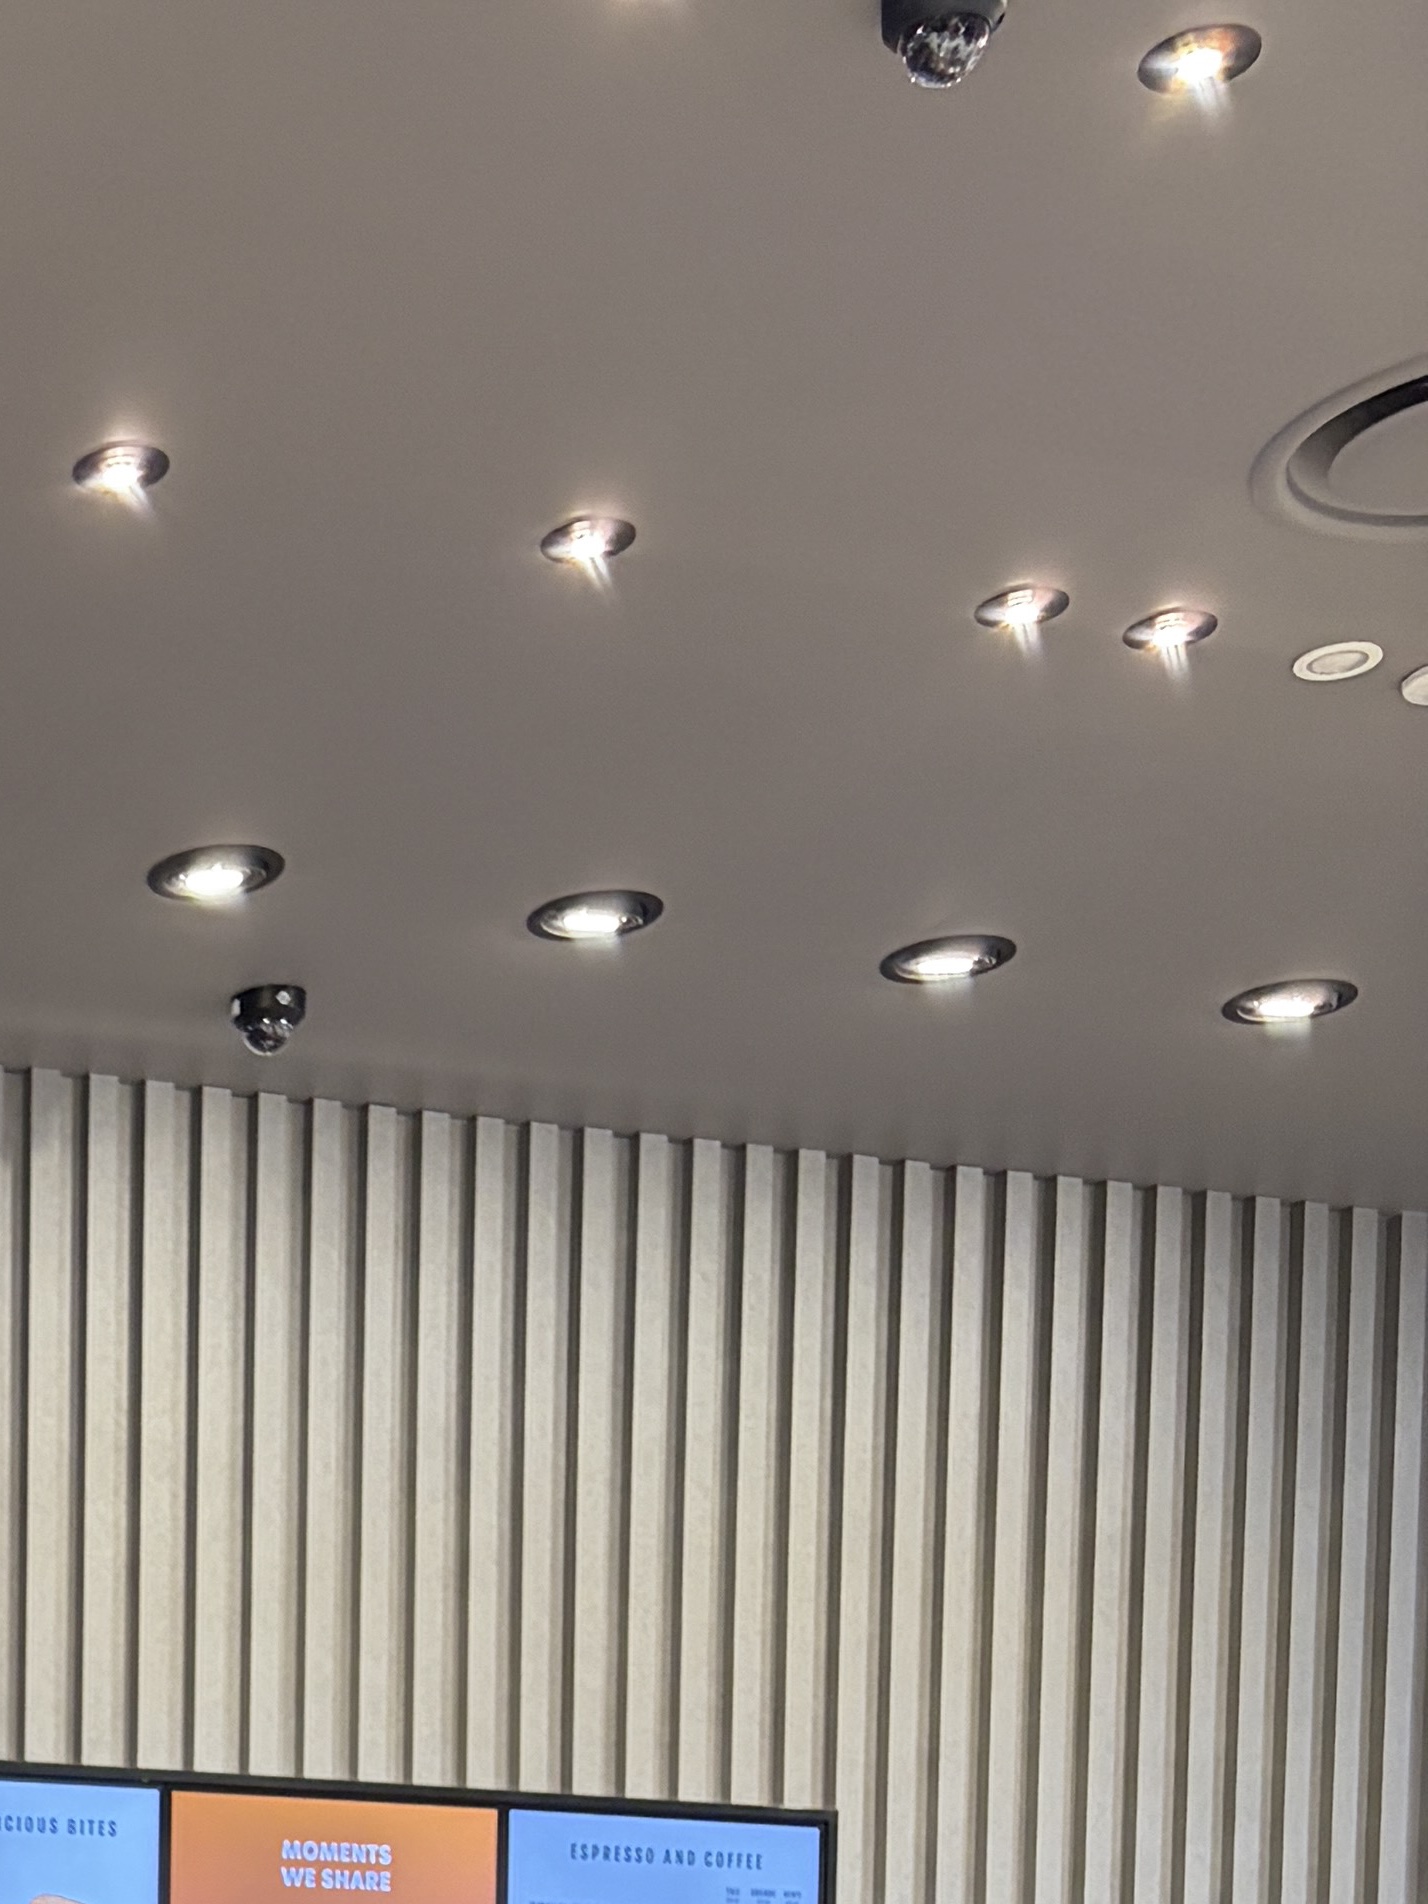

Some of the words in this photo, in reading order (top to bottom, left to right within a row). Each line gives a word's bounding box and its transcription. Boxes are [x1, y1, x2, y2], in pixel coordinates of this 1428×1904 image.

[67, 1818, 118, 1837] BITES
[281, 1839, 392, 1865] MOMENTS
[570, 1842, 654, 1864] ESPRESSO
[662, 1848, 696, 1866] AND
[704, 1851, 764, 1870] COFFEE
[281, 1866, 316, 1888] WE
[321, 1868, 392, 1892] SHARE
